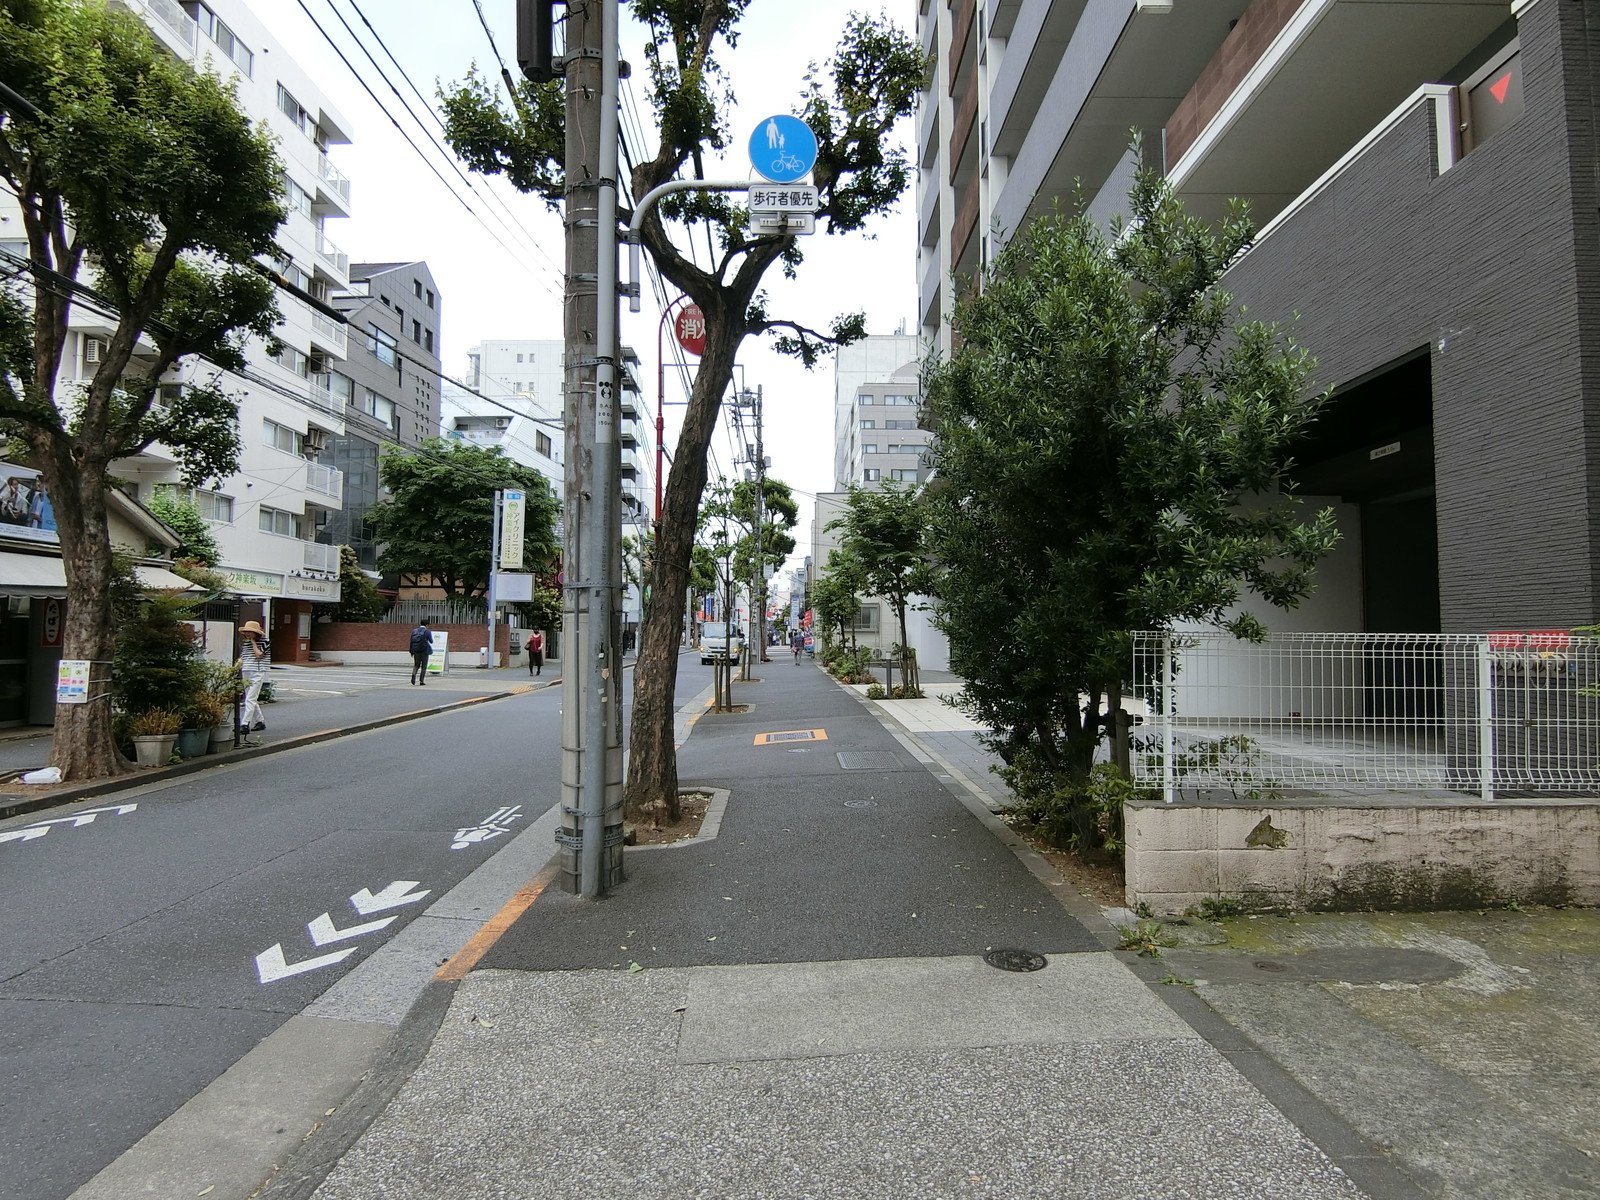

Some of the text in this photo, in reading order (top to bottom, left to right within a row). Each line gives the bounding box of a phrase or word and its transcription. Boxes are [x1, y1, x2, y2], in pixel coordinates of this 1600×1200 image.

[754, 191, 813, 206] 歩行者優先
[680, 318, 707, 340] 消火
[512, 512, 521, 559] アイクリニック
[48, 603, 59, 639] たばこ
